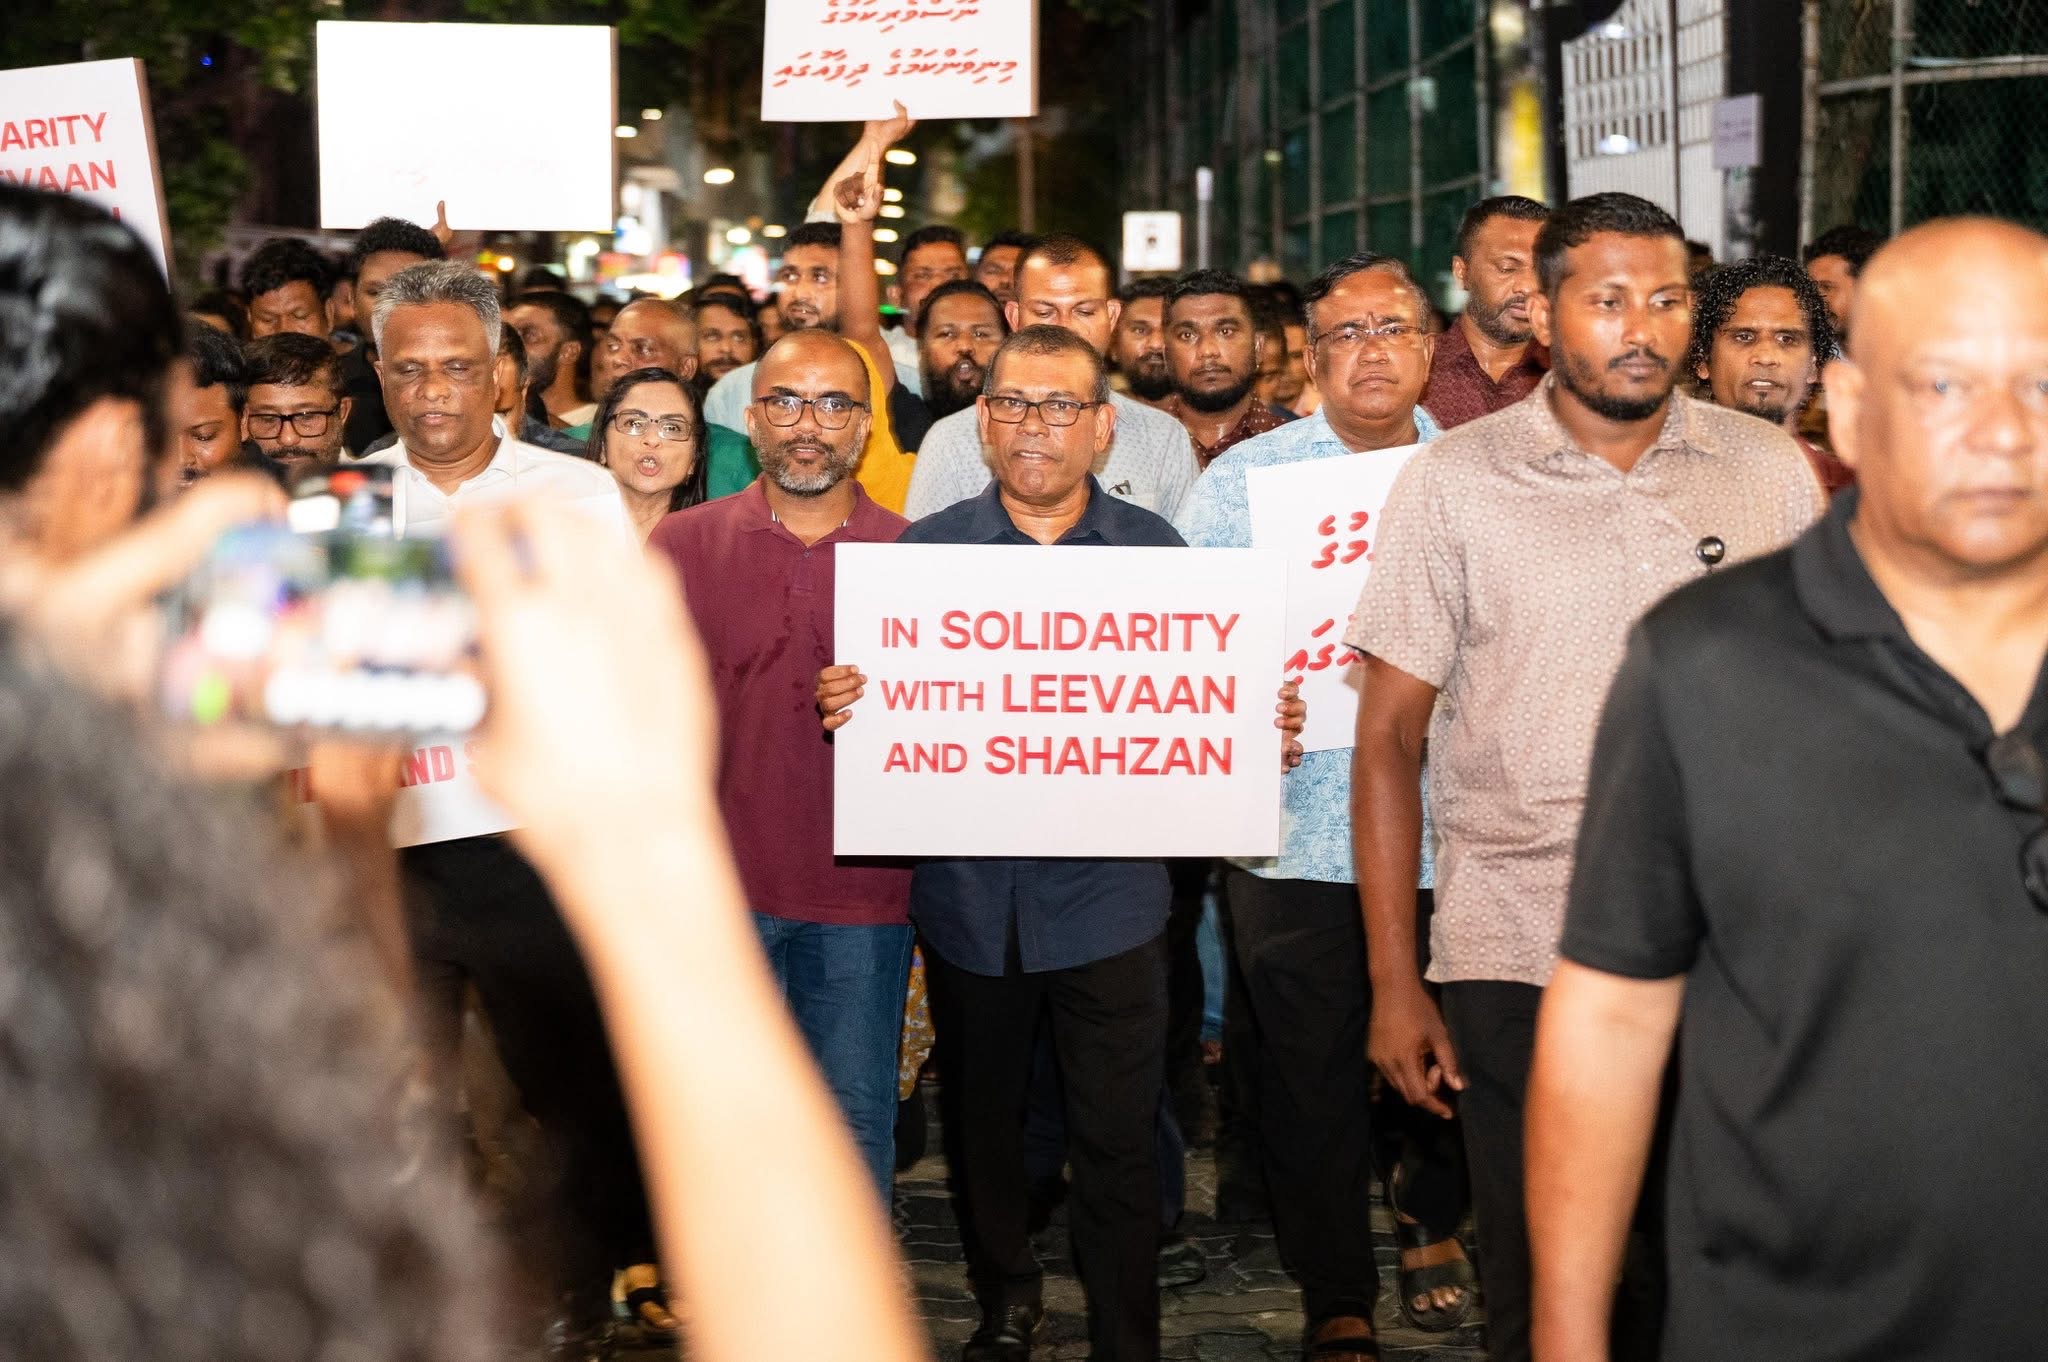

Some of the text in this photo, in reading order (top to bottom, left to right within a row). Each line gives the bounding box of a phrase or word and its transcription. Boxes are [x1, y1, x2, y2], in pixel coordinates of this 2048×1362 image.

[0, 111, 107, 152] ARITY
[0, 159, 117, 194] VAAN
[881, 610, 1240, 652] IN SOLIDARITY
[880, 674, 1236, 714] WITH LEEVAAN
[400, 745, 456, 788] ND
[883, 735, 1233, 776] AND SHAHZAN
